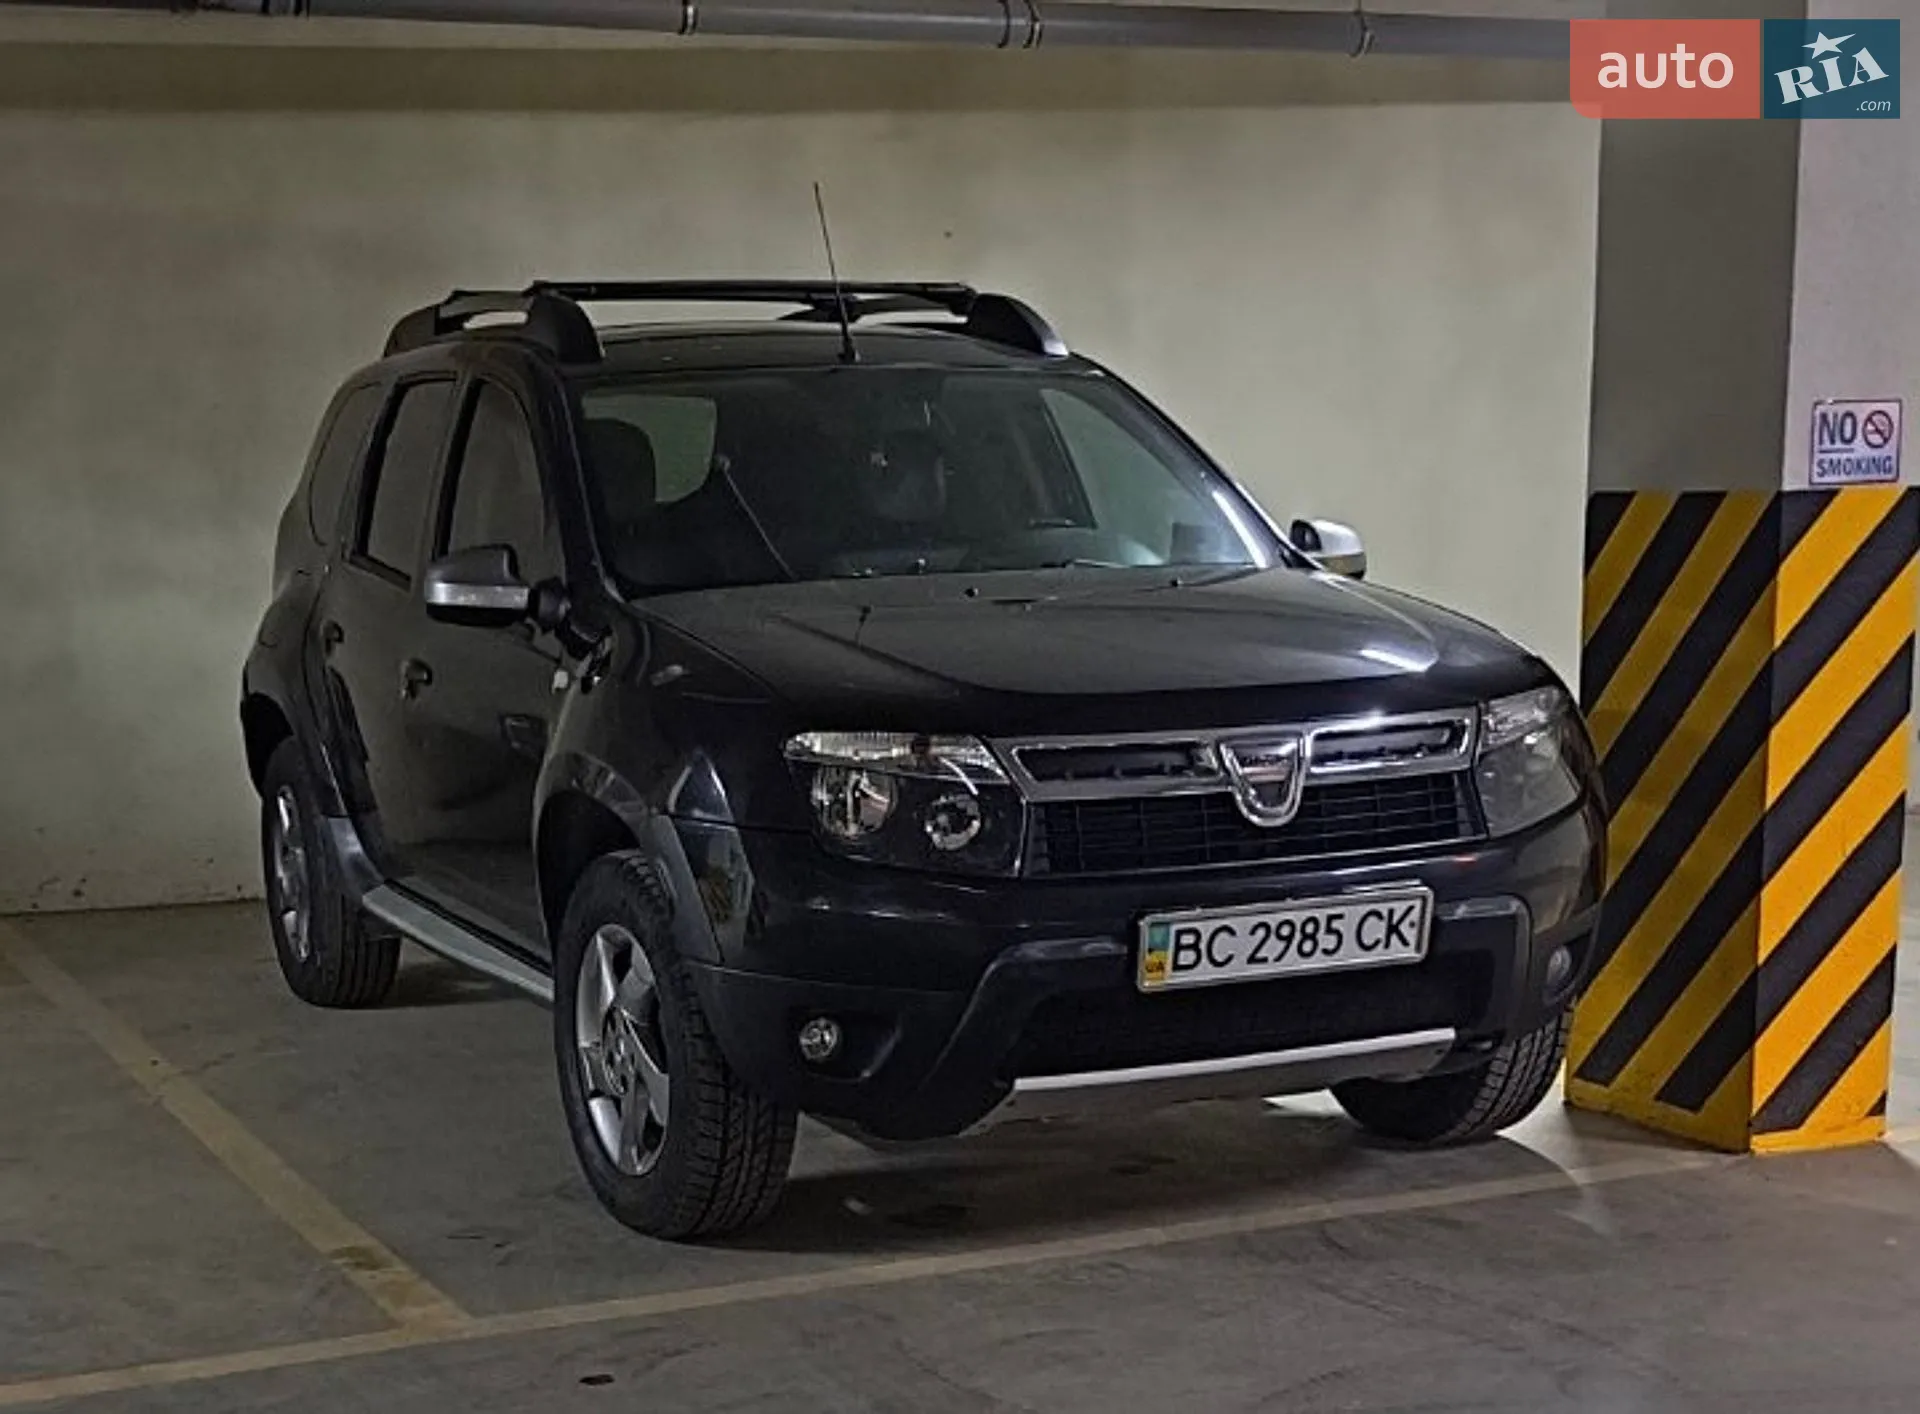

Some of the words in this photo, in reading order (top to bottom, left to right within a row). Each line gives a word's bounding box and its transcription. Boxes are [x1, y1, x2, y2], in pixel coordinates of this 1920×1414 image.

[1818, 410, 1858, 446] NO
[1816, 455, 1893, 478] SMOKING
[1172, 924, 1238, 972] BC
[1247, 913, 1345, 965] 2985
[1355, 904, 1416, 952] CK
